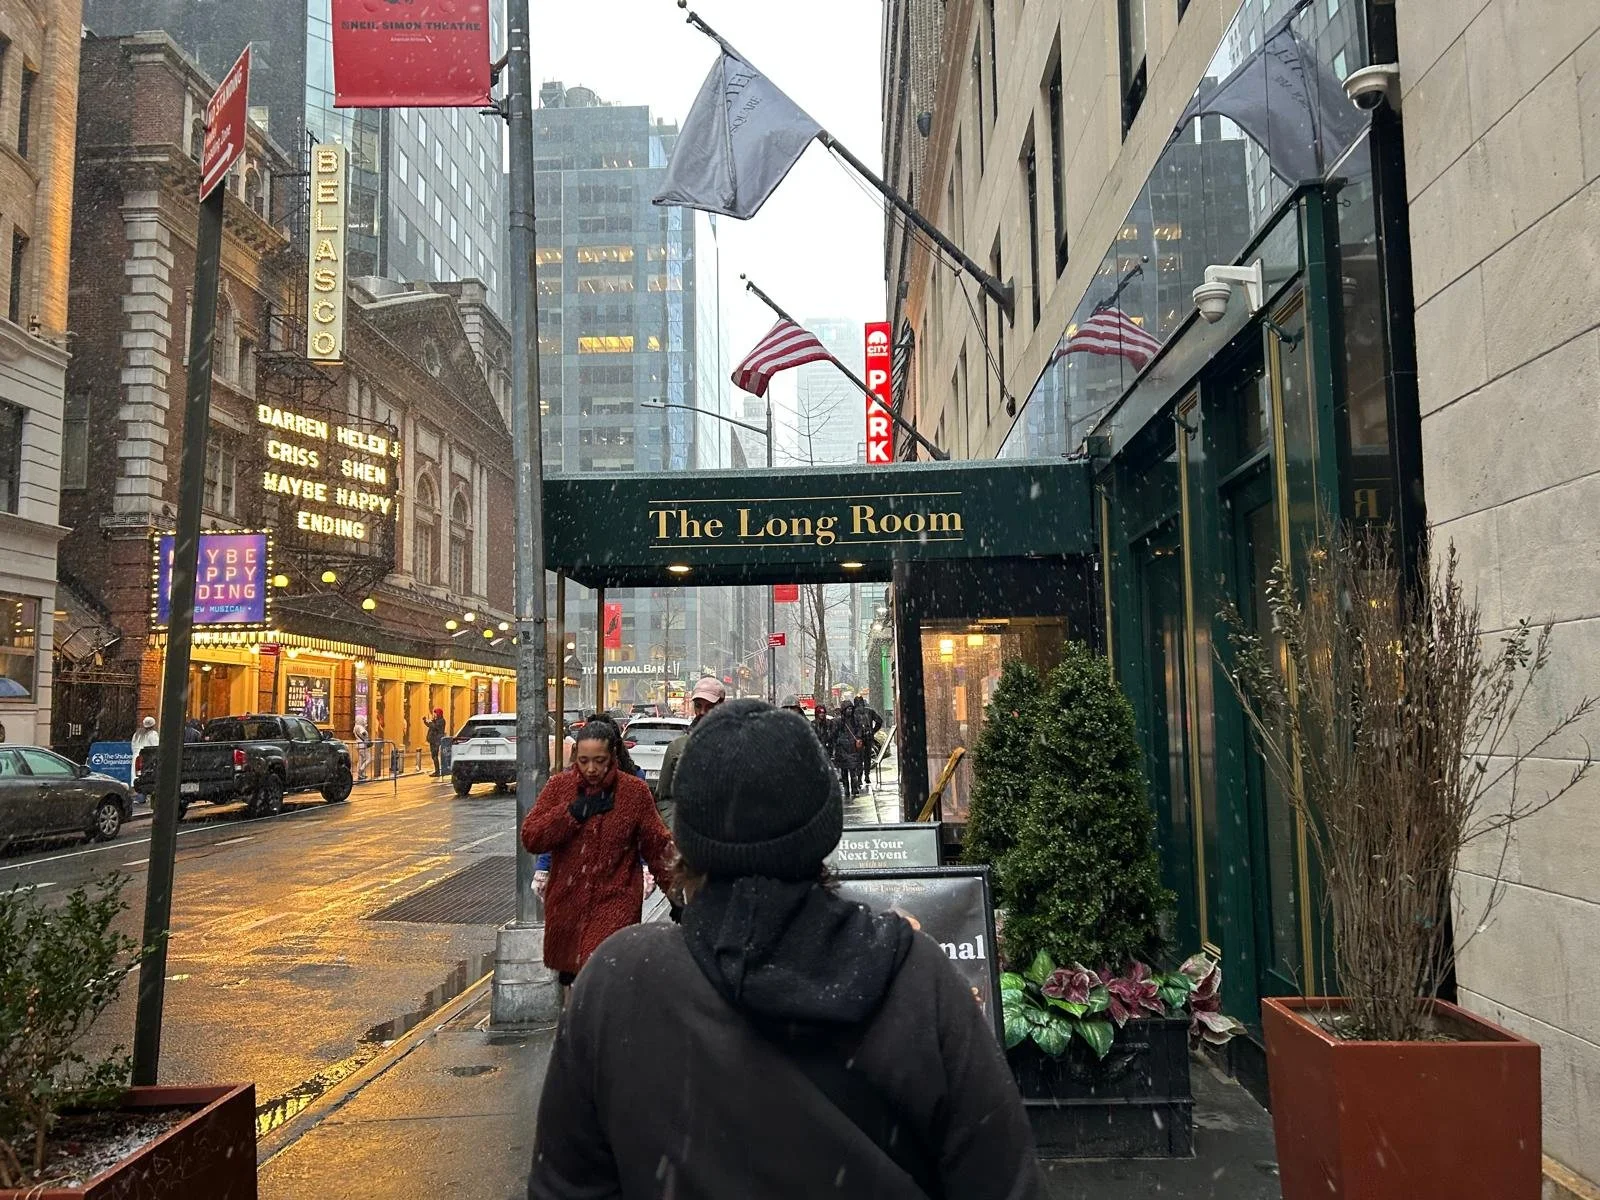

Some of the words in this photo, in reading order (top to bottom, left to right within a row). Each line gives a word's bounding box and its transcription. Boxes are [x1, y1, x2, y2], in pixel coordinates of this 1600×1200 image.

[351, 21, 377, 30] NEIL
[382, 21, 422, 30] SIMON
[426, 21, 481, 31] THEATRE
[215, 65, 243, 117] STANDING
[729, 96, 762, 134] SQUARE
[312, 150, 339, 355] BELASCO
[258, 404, 328, 440] DARREN
[868, 369, 889, 462] PARK
[267, 440, 320, 468] CRISS
[337, 425, 387, 456] HELEN
[341, 459, 387, 485] SHEN
[263, 471, 328, 502] MAYBE
[336, 487, 392, 516] HAPPY
[297, 510, 365, 540] ENDING
[649, 510, 723, 539] The
[736, 508, 838, 546] Long
[849, 504, 964, 535] Room
[209, 605, 245, 613] MUSICAL
[837, 850, 868, 861] Next
[870, 849, 908, 860] Event
[838, 840, 870, 850] Host
[872, 838, 904, 849] Your
[939, 935, 986, 960] nal
